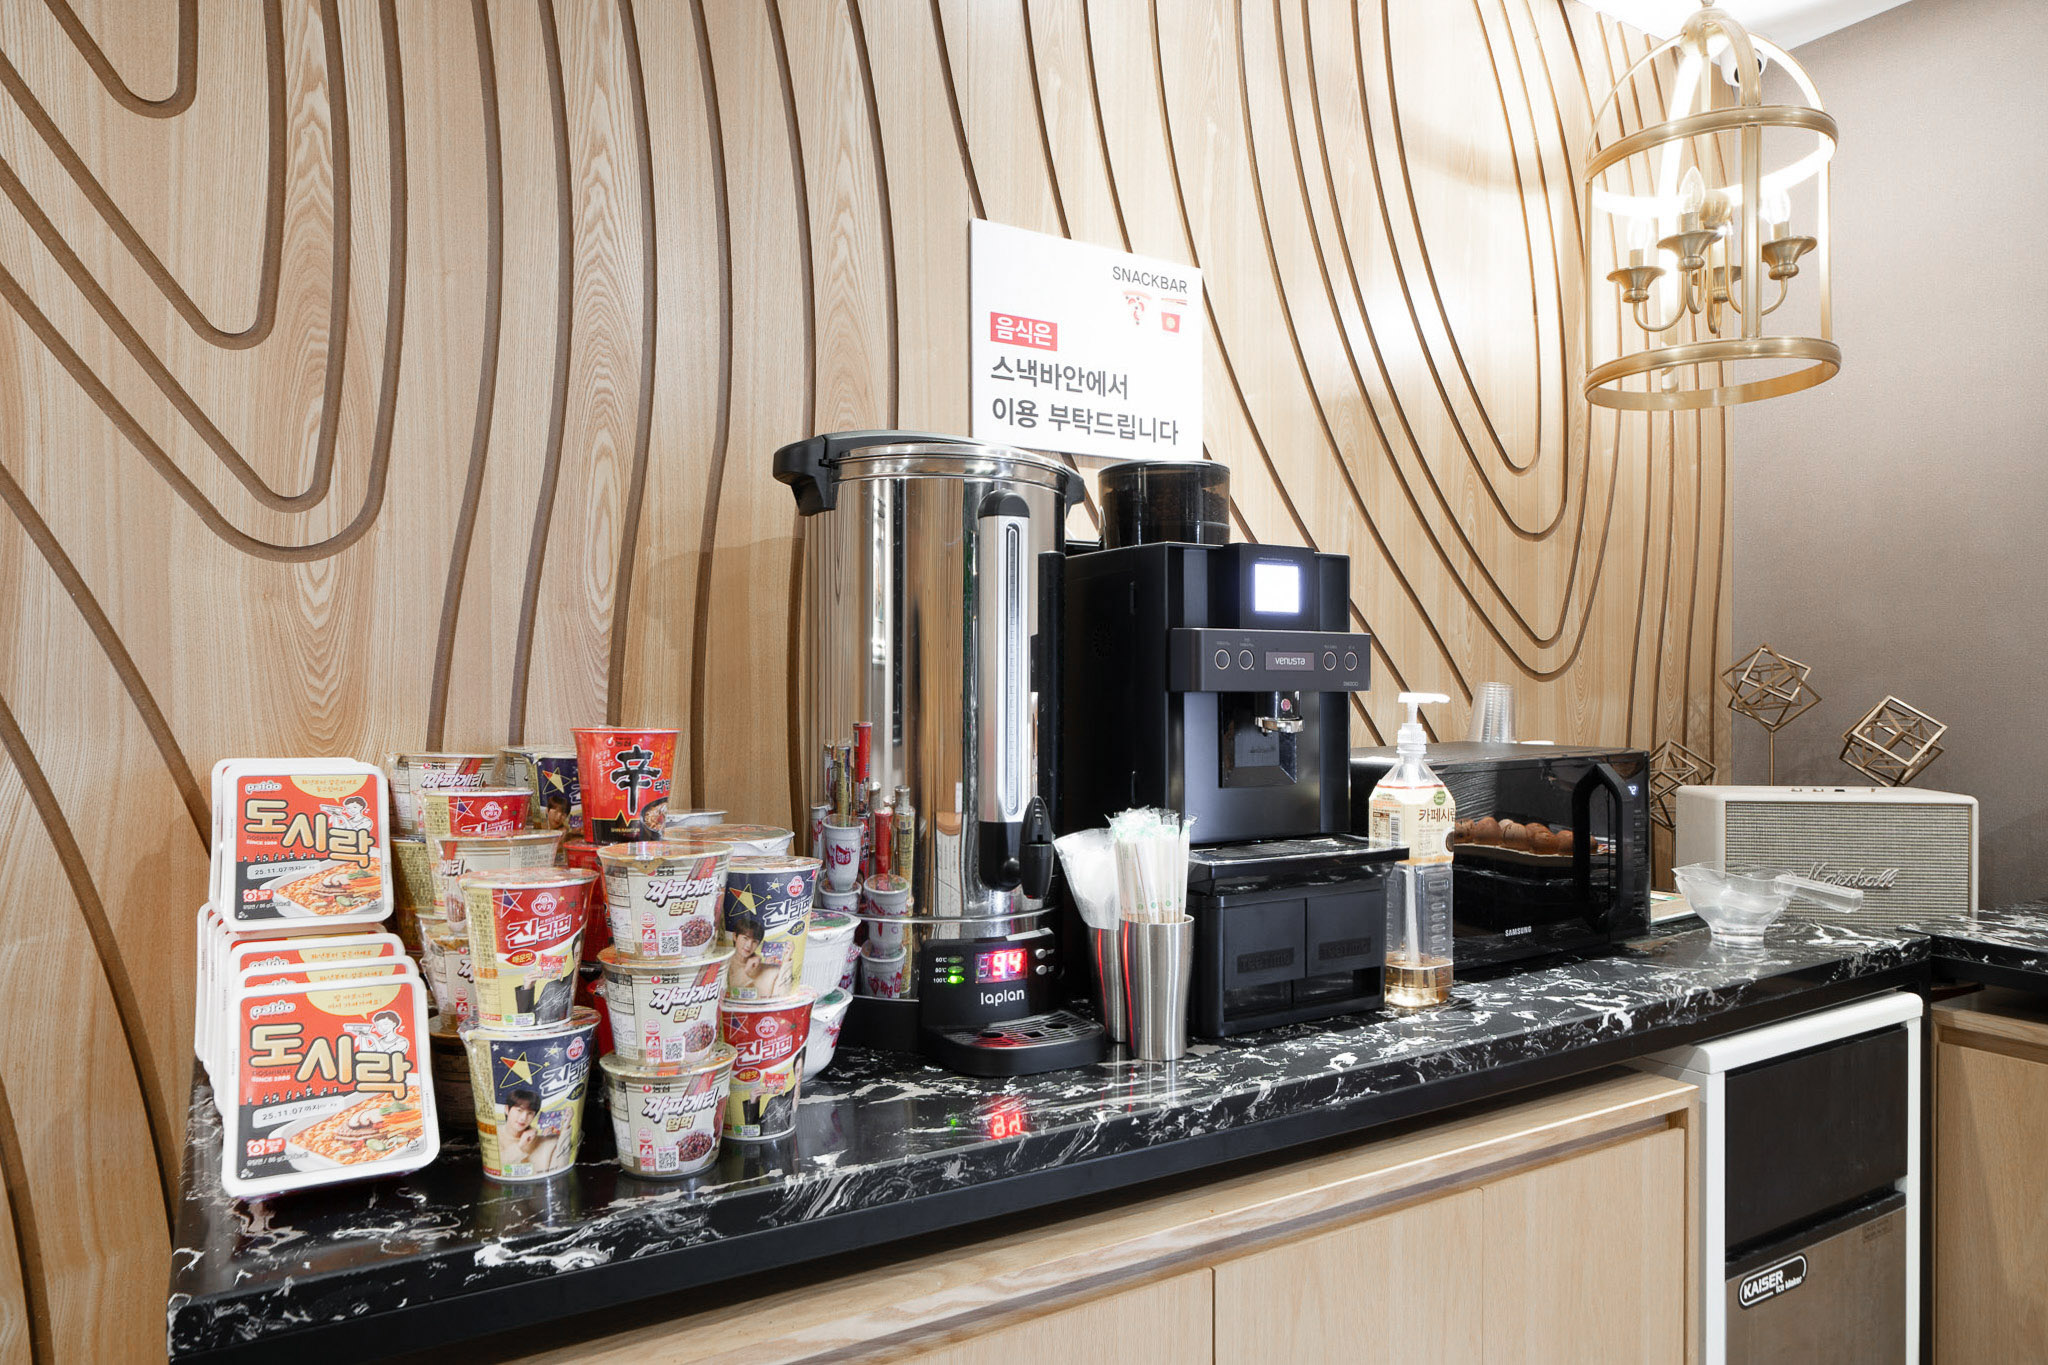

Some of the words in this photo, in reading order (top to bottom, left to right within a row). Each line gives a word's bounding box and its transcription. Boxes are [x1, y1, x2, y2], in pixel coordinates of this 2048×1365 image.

[1112, 266, 1188, 294] SNACKBAR
[995, 316, 1052, 347] 음식은
[990, 356, 1128, 400] 스낵바안에서
[992, 398, 1039, 428] 이용
[1048, 404, 1179, 445] 부탁드립니다
[245, 781, 282, 796] paldo
[420, 772, 485, 789] 짜파게티
[610, 745, 662, 816] 辛
[245, 798, 375, 869] 도시락
[1806, 862, 1900, 889] Marshall
[669, 900, 698, 916] 범벅
[763, 896, 812, 927] 진라면
[505, 914, 573, 949] 진라면
[1504, 926, 1533, 937] SAMSUNG
[992, 951, 1023, 977] 94
[661, 976, 680, 984] 농심
[250, 1000, 296, 1020] paldo
[649, 982, 719, 1015] 짜파게티
[980, 989, 1025, 1007] laplan
[673, 1005, 702, 1023] 범벅
[249, 1023, 413, 1100] 도시락
[736, 1034, 793, 1067] 진라면
[641, 1086, 719, 1124] 짜파게티
[666, 1114, 695, 1132] 범벅
[1743, 1270, 1784, 1300] KAISER
